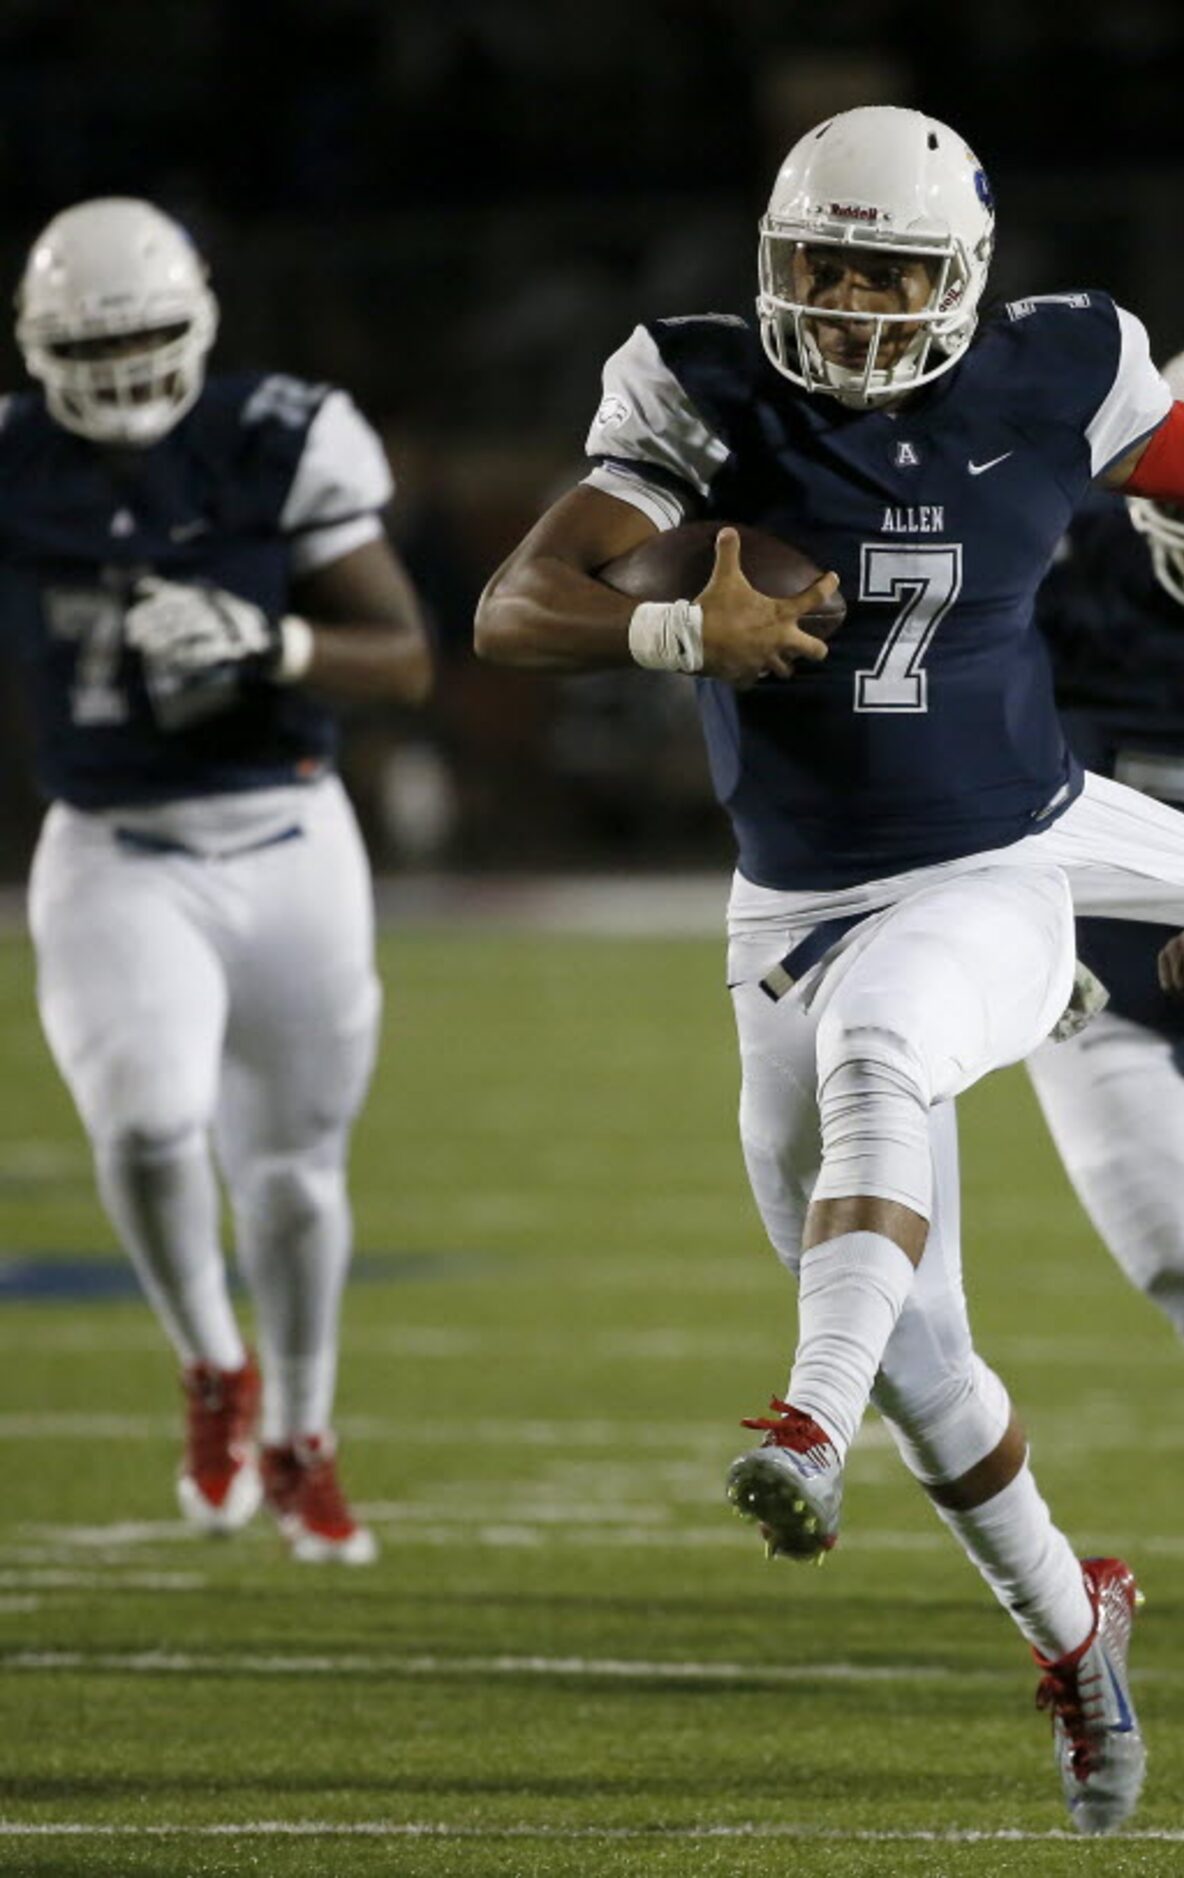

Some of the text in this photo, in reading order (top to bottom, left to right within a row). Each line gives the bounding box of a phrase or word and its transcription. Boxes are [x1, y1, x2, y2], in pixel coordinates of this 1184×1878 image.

[830, 202, 878, 220] Riddell
[896, 441, 919, 467] A
[880, 505, 945, 533] ALLEN
[853, 543, 963, 713] 7
